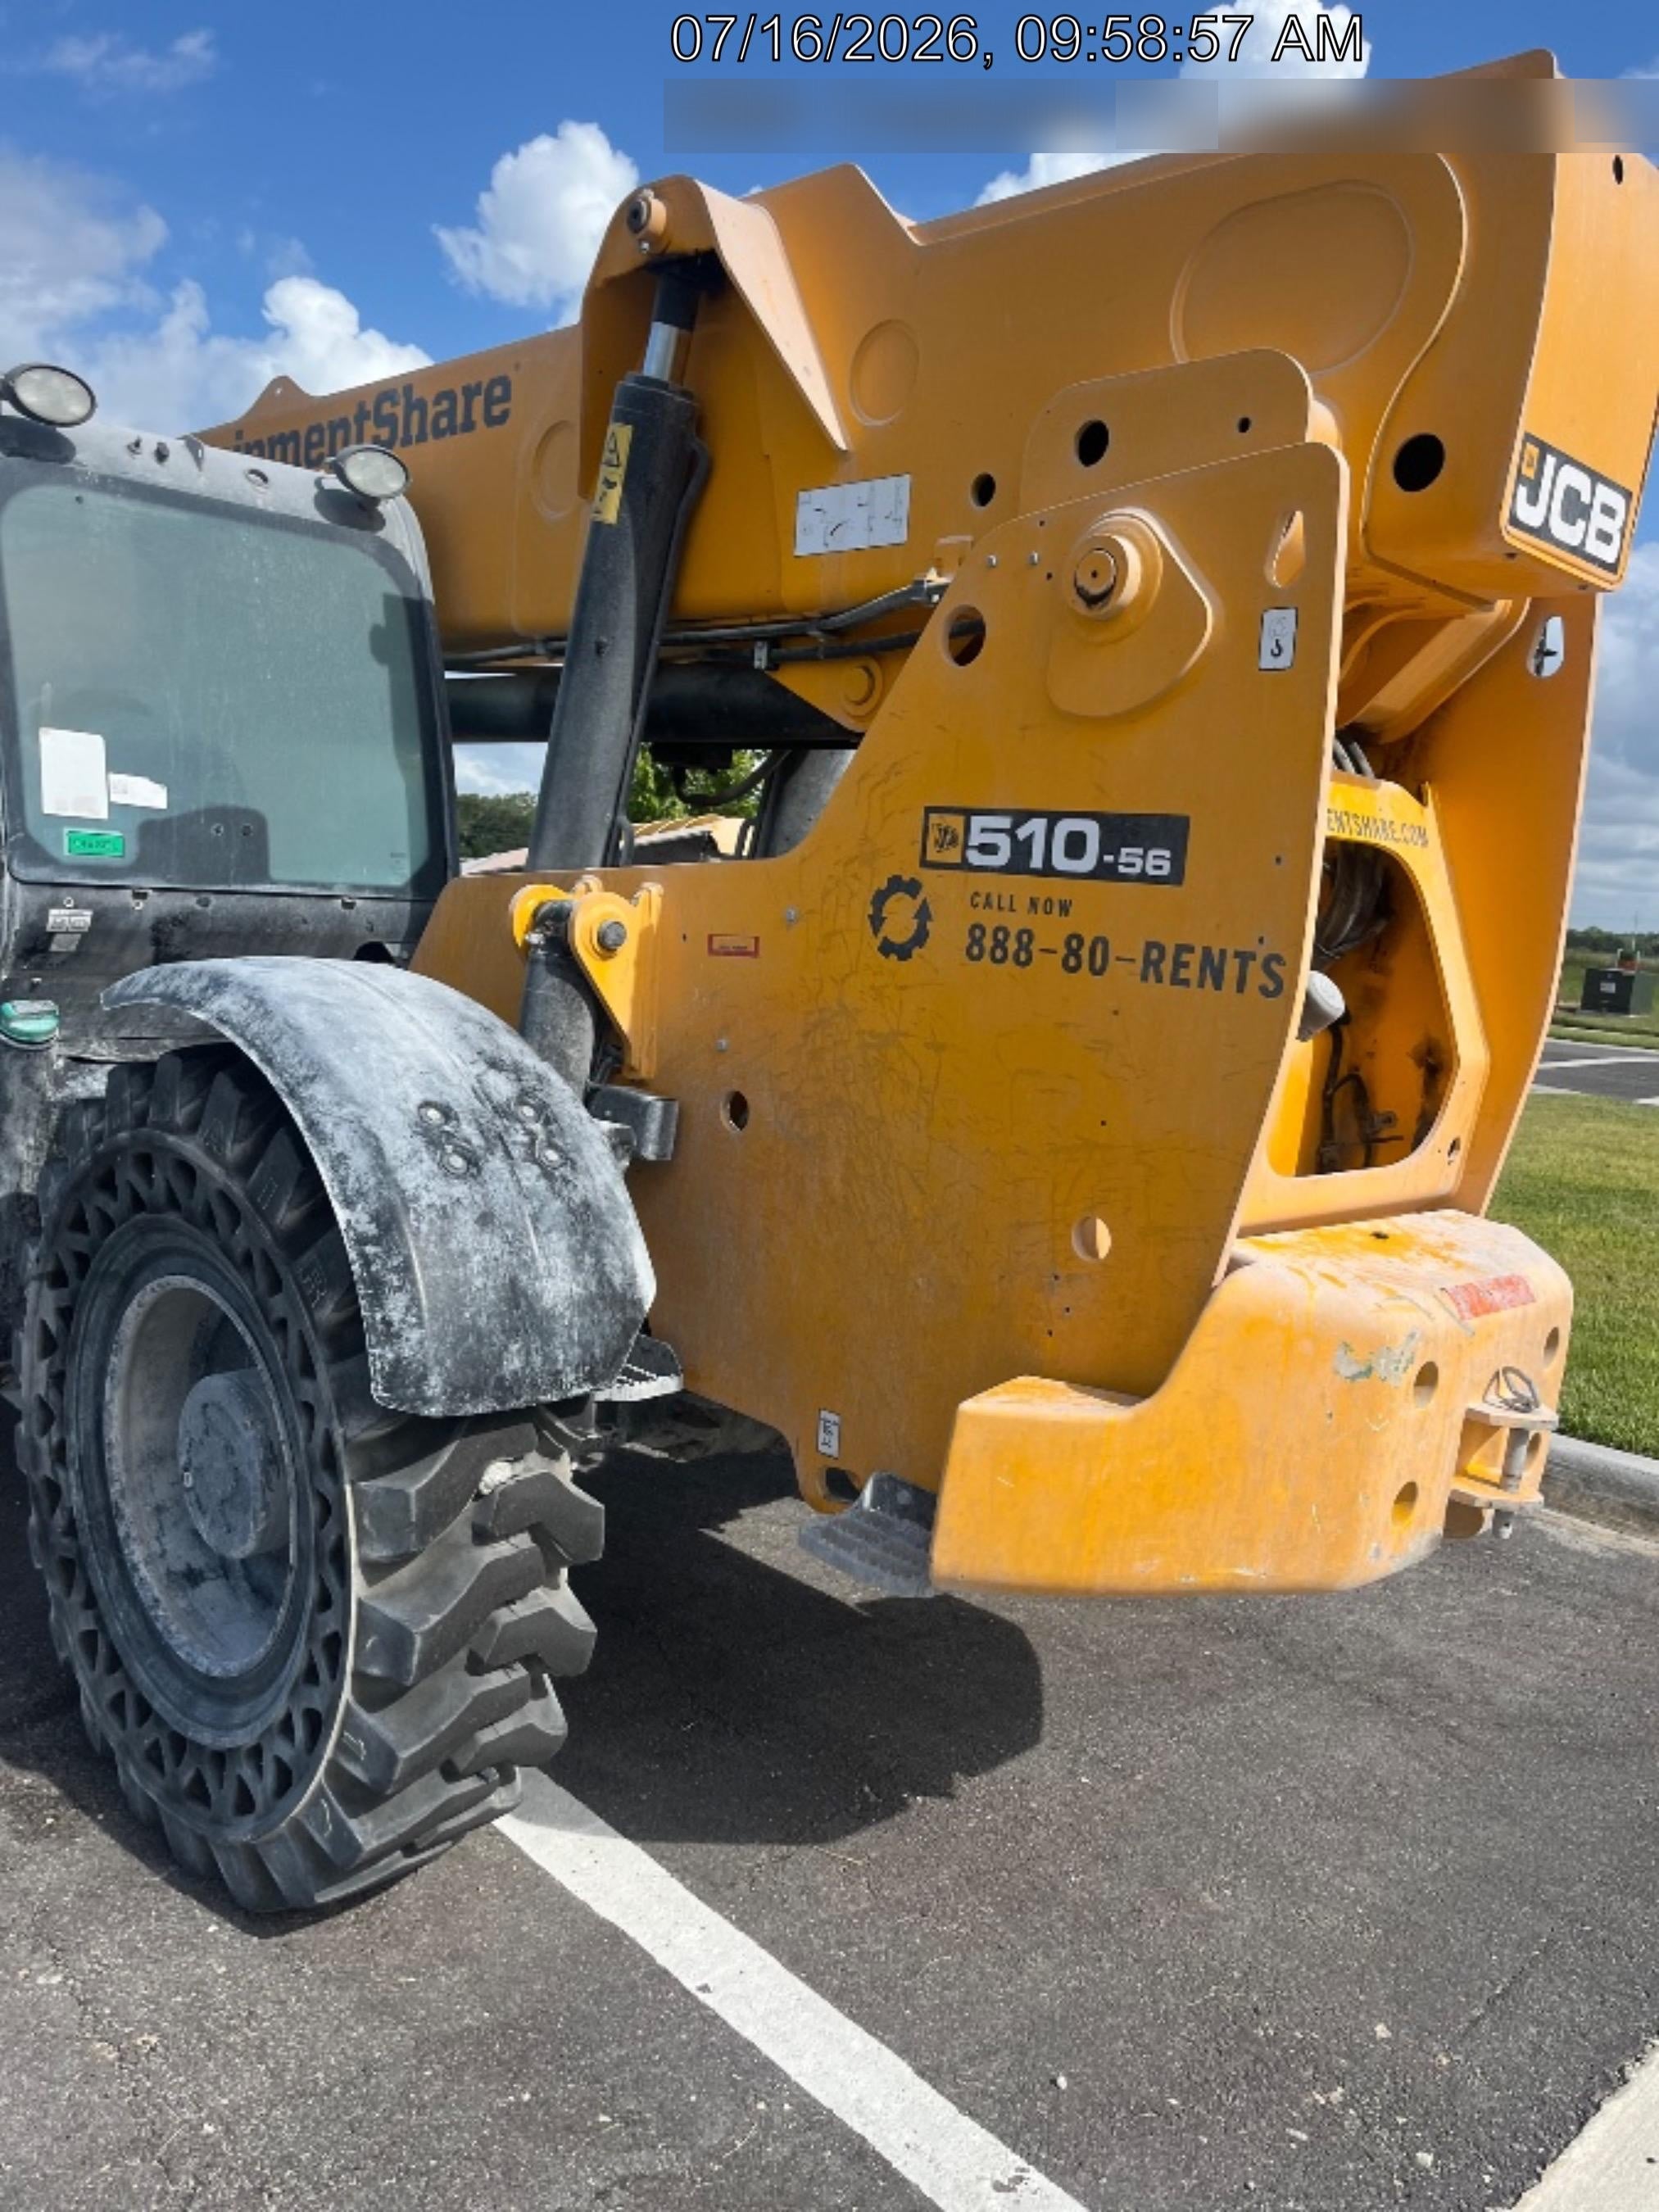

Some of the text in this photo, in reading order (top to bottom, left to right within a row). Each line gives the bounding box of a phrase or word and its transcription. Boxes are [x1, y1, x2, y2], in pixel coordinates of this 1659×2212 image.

[1516, 454, 1626, 564] JCB
[970, 891, 1073, 918] CALL NOW
[965, 922, 1287, 999] 888-80-RENTS
